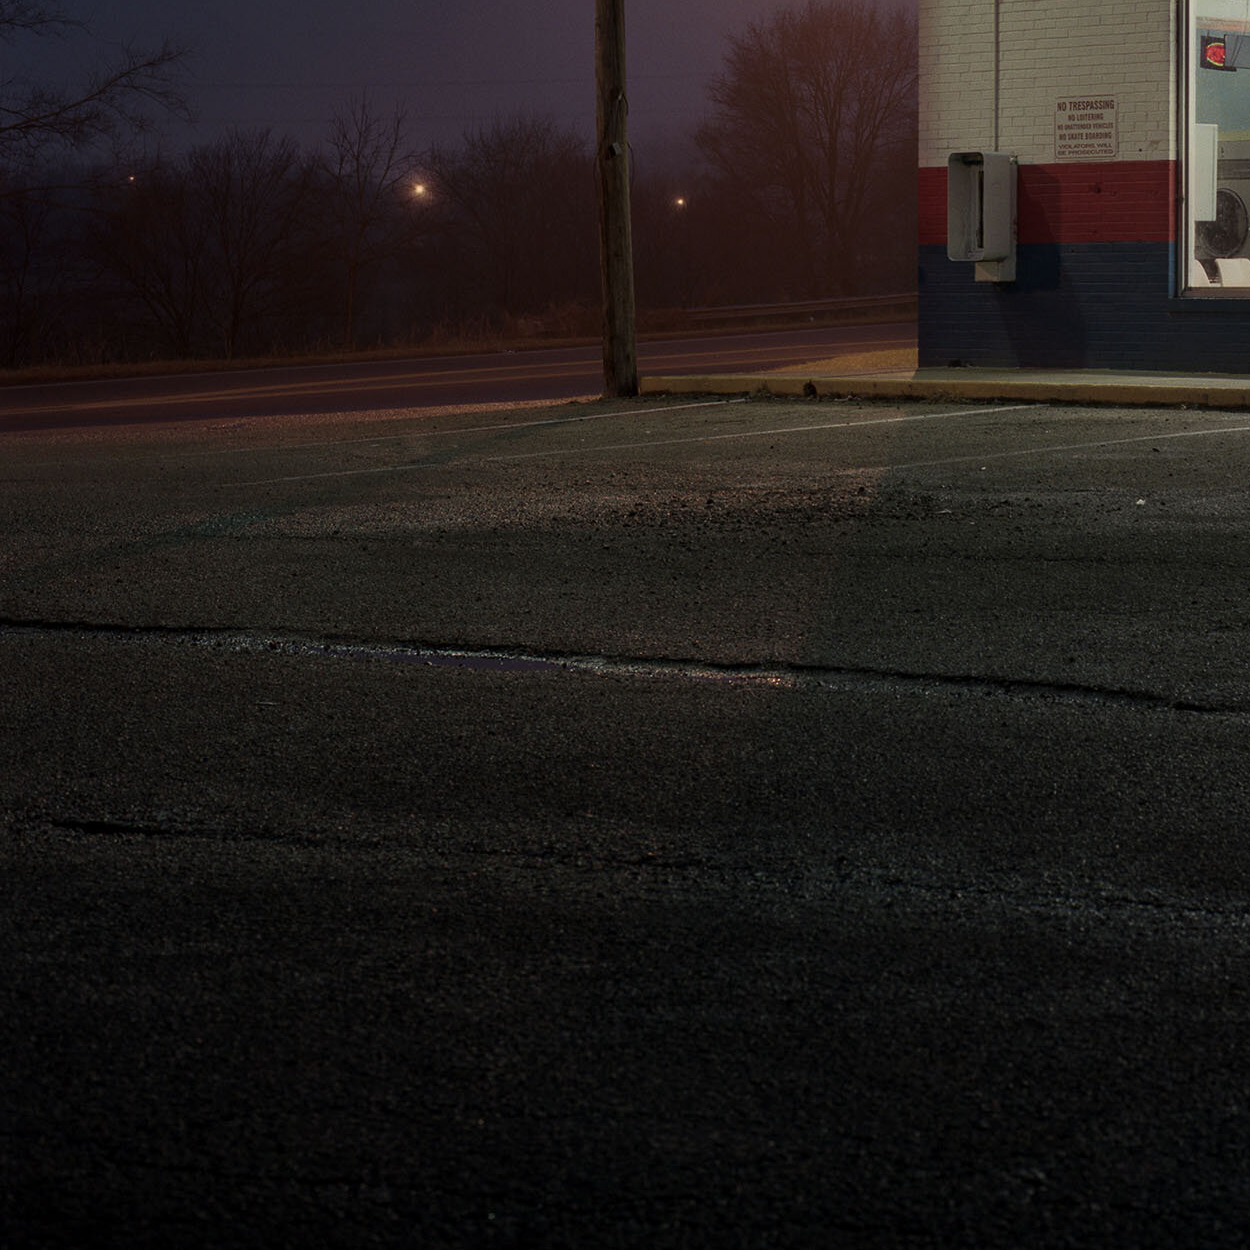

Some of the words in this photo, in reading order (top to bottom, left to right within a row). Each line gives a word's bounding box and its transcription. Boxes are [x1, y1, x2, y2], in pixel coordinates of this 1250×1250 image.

[1057, 101, 1067, 111] NO
[1069, 100, 1115, 110] TRESPASSING
[1077, 113, 1104, 121] LOITERING
